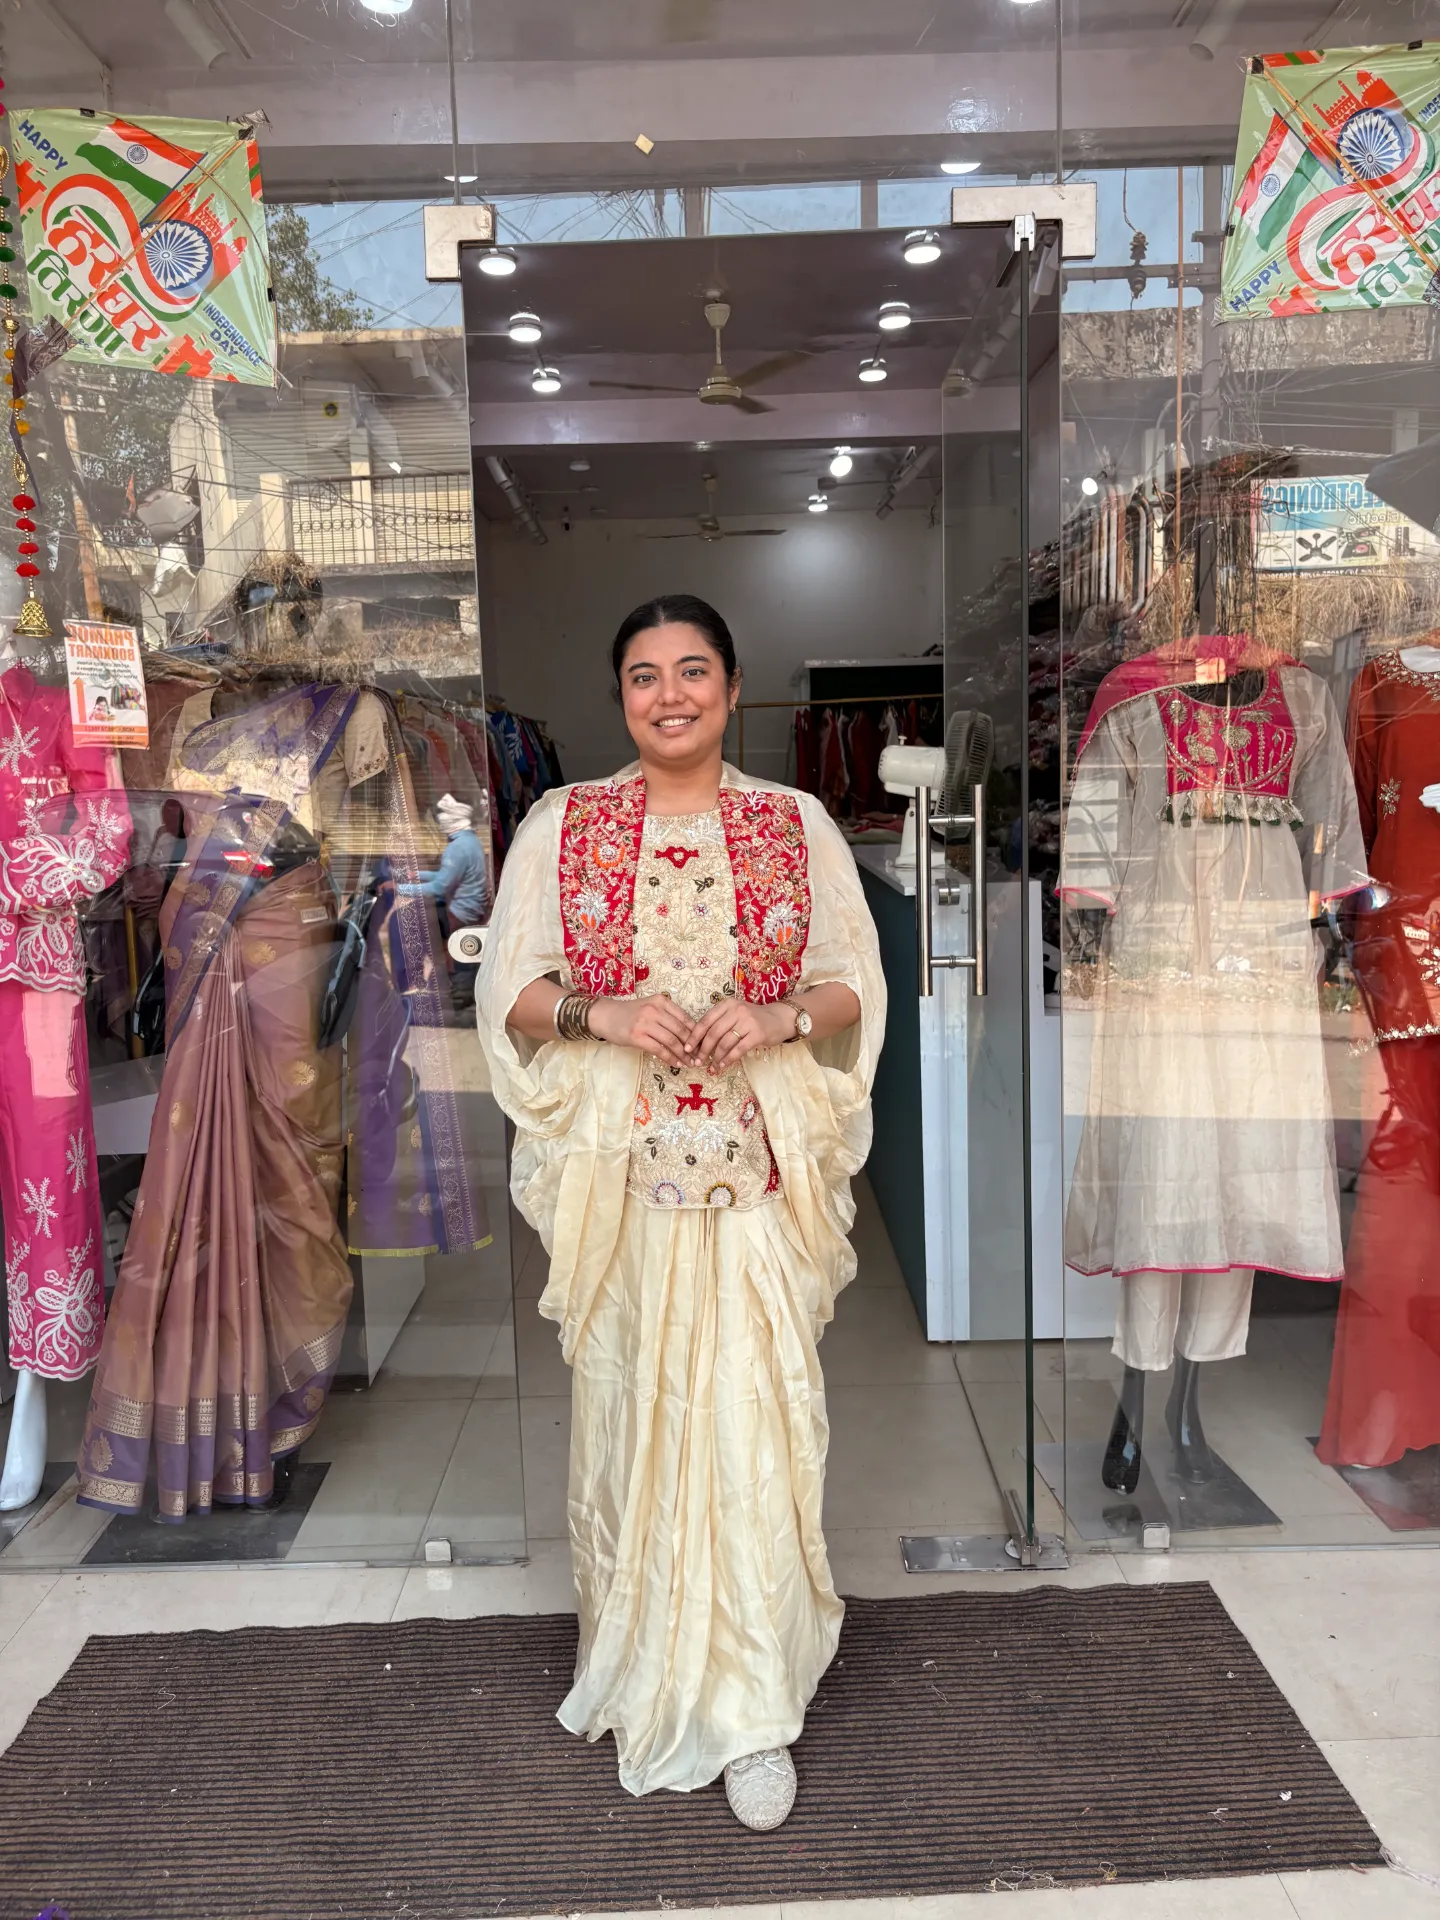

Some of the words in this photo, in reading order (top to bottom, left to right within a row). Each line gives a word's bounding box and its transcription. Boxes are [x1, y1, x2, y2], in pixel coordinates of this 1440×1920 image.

[18, 119, 68, 171] HAPPY
[26, 247, 129, 358] तिरंगा
[47, 209, 133, 289] हर
[96, 280, 168, 352] घर
[1229, 260, 1281, 312] HAPPY
[202, 302, 263, 367] INDEPENDENCE
[210, 328, 238, 357] DAY
